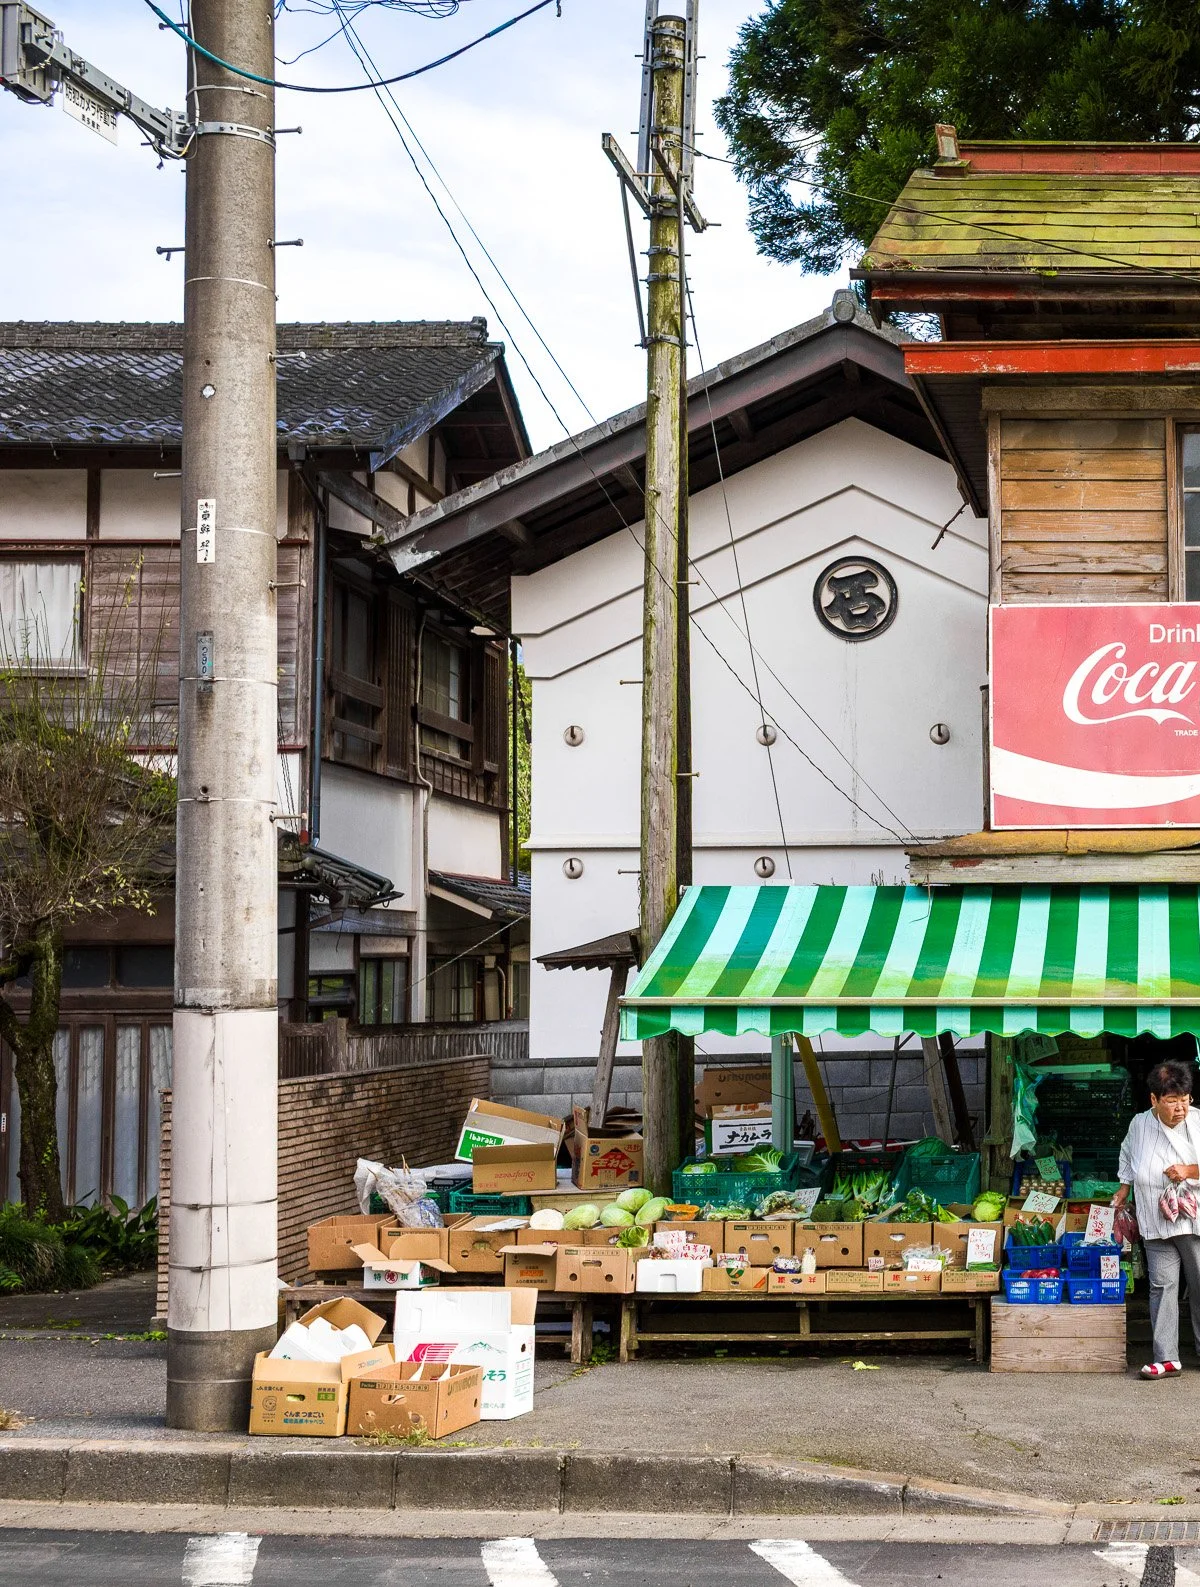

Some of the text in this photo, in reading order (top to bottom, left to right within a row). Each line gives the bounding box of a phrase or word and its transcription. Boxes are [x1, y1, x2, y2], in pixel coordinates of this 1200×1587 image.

[468, 1132, 497, 1145] Ibaraki
[724, 1129, 772, 1144] ナカムラ
